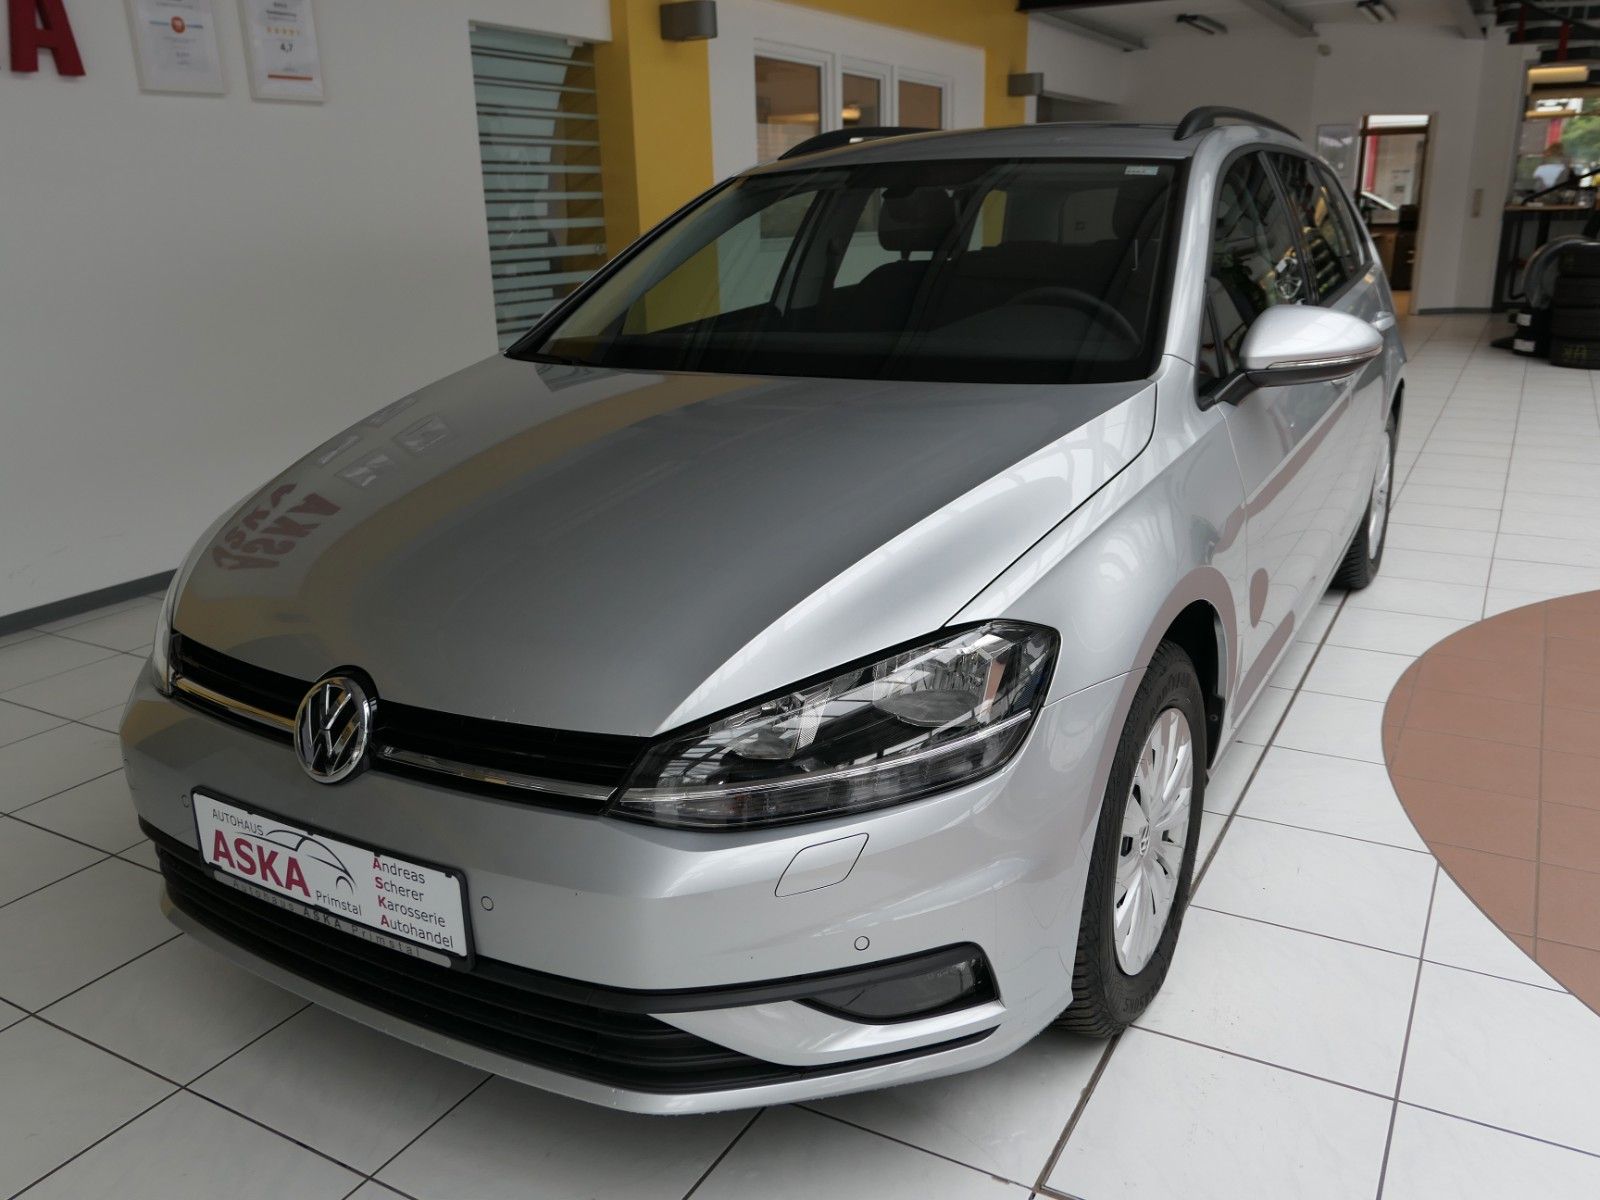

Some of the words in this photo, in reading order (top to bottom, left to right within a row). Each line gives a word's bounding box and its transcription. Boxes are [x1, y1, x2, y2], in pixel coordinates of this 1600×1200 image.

[212, 808, 264, 836] AUTOHAUS
[213, 829, 311, 898] ASKA
[373, 857, 426, 884] Andreas
[315, 890, 362, 916] Primstal
[375, 876, 424, 902] Scherer
[378, 894, 446, 928] Karosserie
[303, 905, 342, 930] ASKA
[351, 925, 421, 957] Primstal
[380, 914, 454, 949] Autohandel
